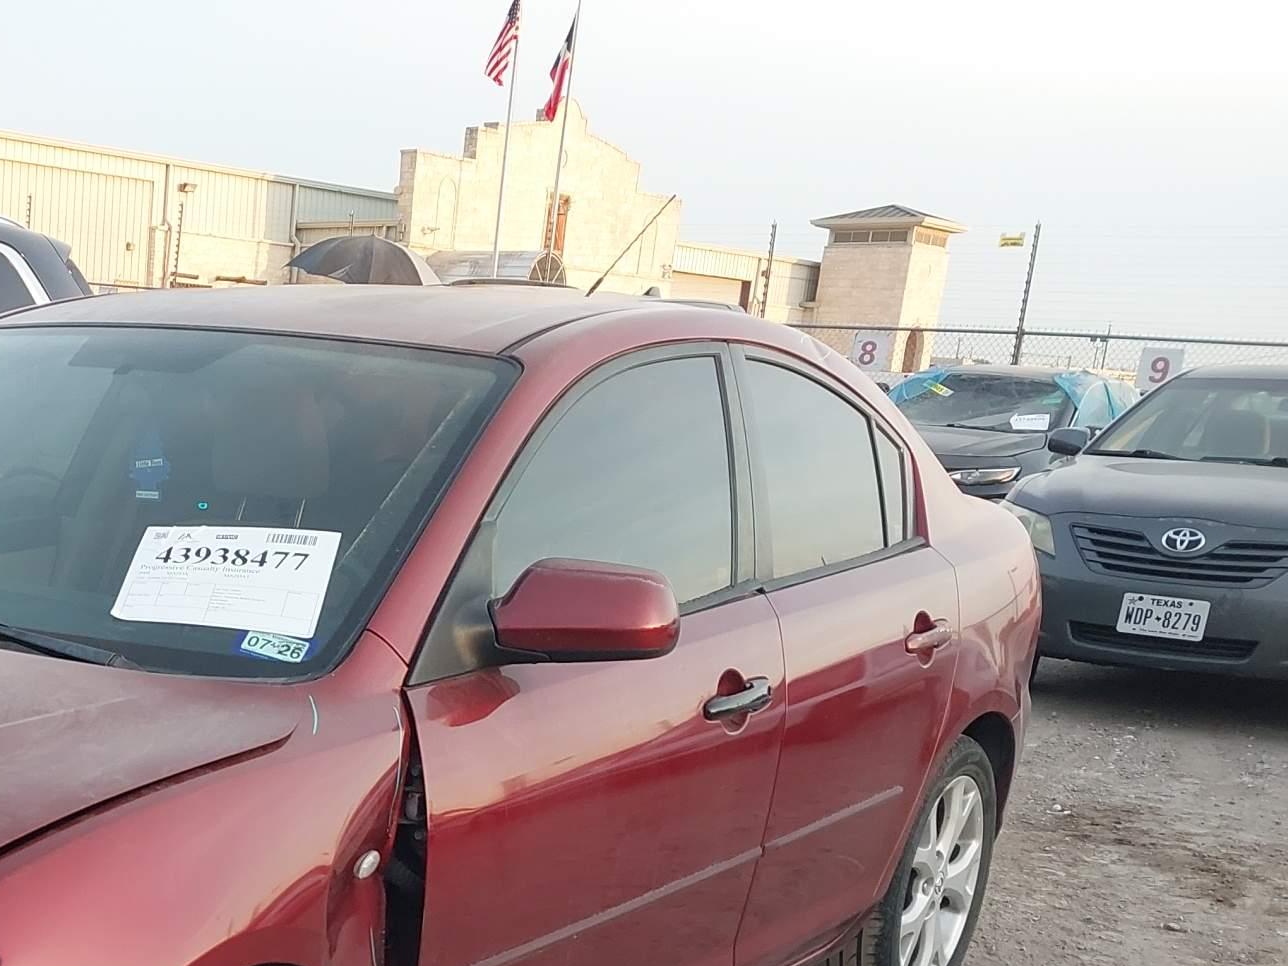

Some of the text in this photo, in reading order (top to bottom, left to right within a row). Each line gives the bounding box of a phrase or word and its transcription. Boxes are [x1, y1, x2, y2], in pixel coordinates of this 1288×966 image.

[858, 341, 877, 365] 8
[1149, 357, 1169, 383] 9
[155, 546, 310, 571] 43938477
[1150, 598, 1183, 609] TEXAS
